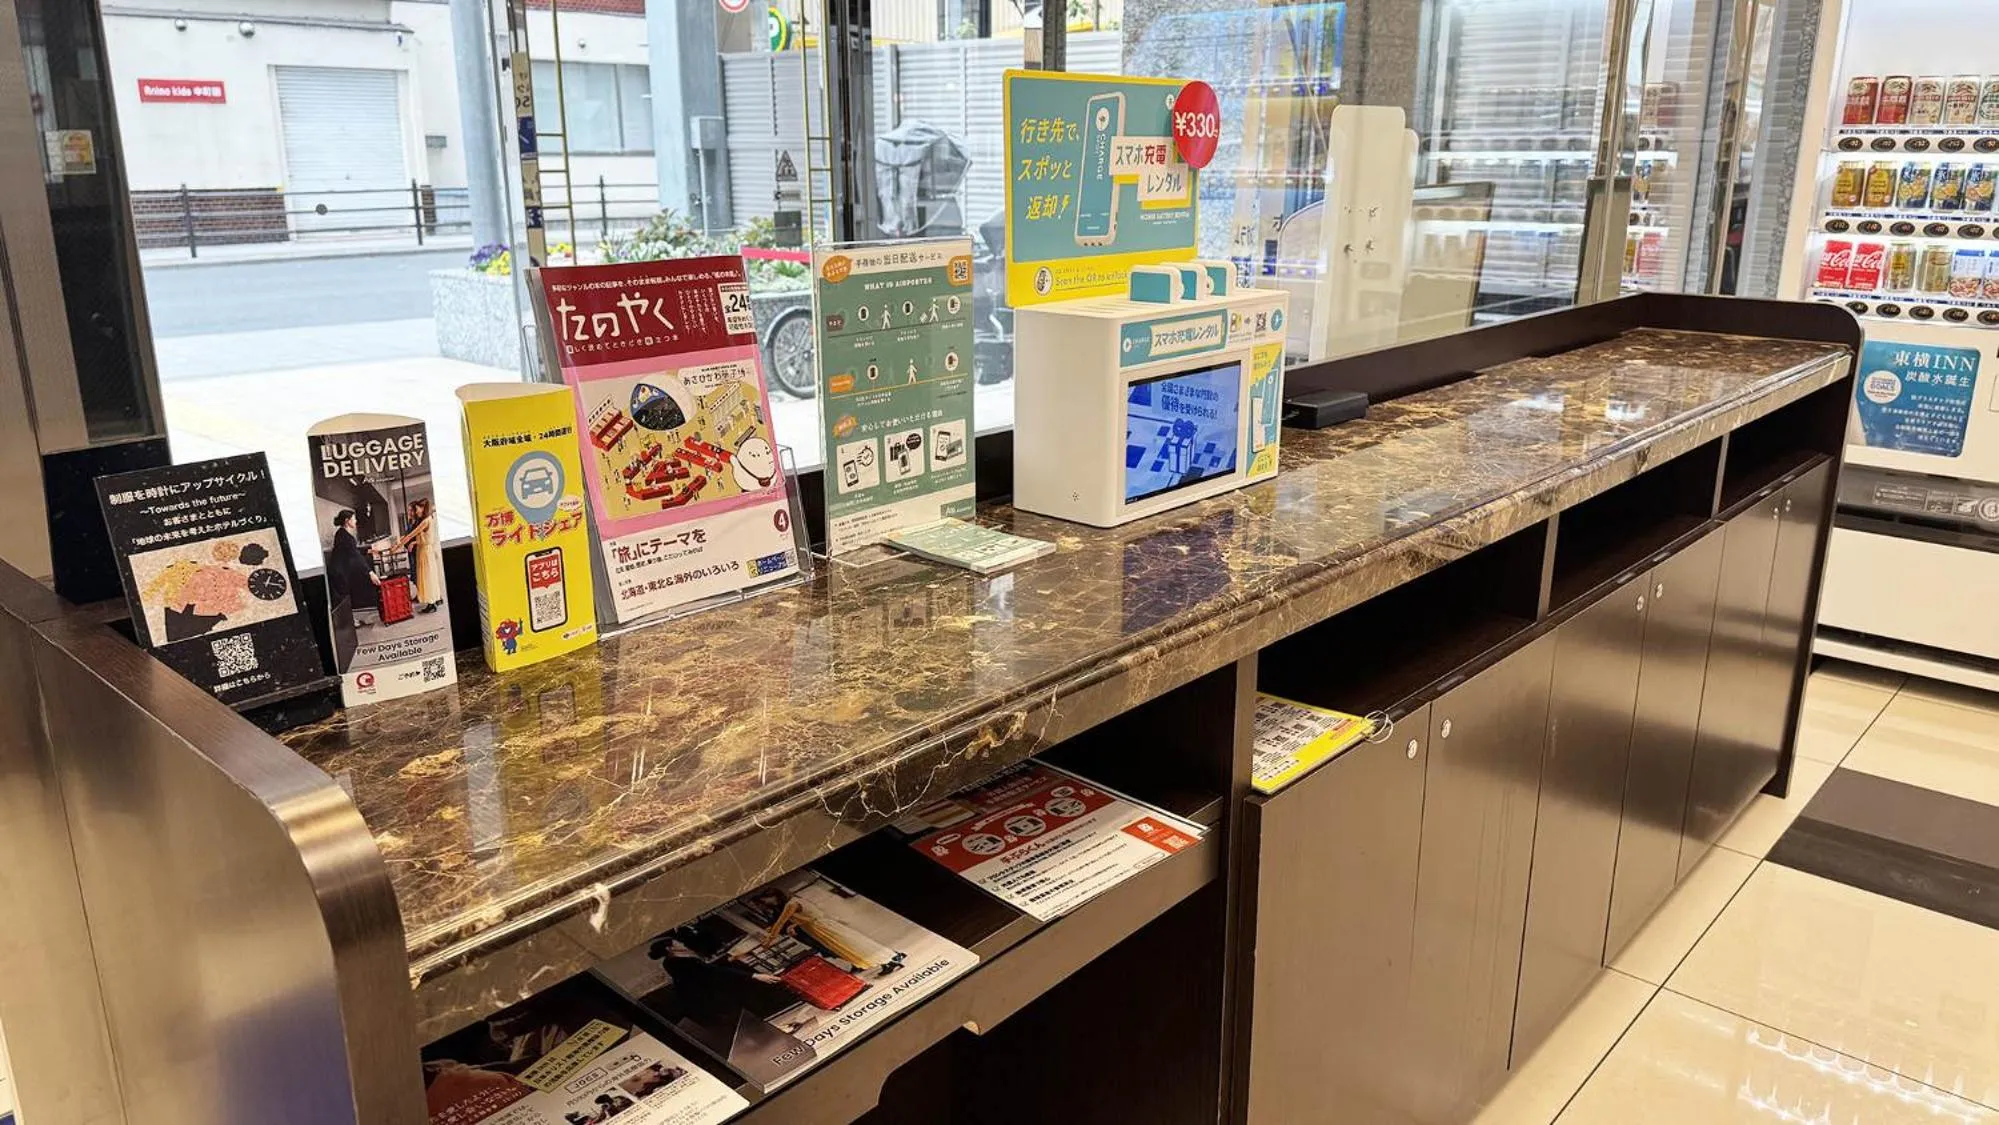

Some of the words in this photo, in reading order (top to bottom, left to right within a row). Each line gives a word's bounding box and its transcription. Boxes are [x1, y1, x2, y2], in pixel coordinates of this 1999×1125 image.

[1020, 117, 1080, 143] 行き先で、
[1175, 112, 1215, 138] ¥330
[1097, 133, 1106, 180] CHARGE
[1115, 144, 1167, 165] スマホ充電
[1018, 155, 1072, 180] スポッと
[1147, 172, 1181, 193] レンタル
[864, 283, 884, 291] WHAT
[555, 292, 675, 341] たのやく
[1154, 323, 1219, 347] スマホ充電レンタル
[1895, 350, 1976, 372] 東横INN
[1905, 371, 1970, 387] 炭酸水誕生
[321, 433, 423, 461] LUGGAGE
[323, 450, 424, 478] DELIVERY
[192, 497, 208, 508] the
[163, 507, 232, 526] お客さまとともに
[778, 512, 786, 529] 4
[491, 511, 582, 546] ライドシェア
[611, 528, 707, 564] 「旅」にテーマを
[531, 559, 558, 572] アプリは
[532, 567, 559, 582] こちら
[357, 646, 377, 655] Few
[378, 643, 402, 653] Days
[403, 633, 439, 647] Storage
[378, 647, 423, 661] Available
[772, 1045, 803, 1066] Few
[804, 1023, 841, 1048] Days
[839, 992, 894, 1026] Storage
[893, 957, 951, 996] Available
